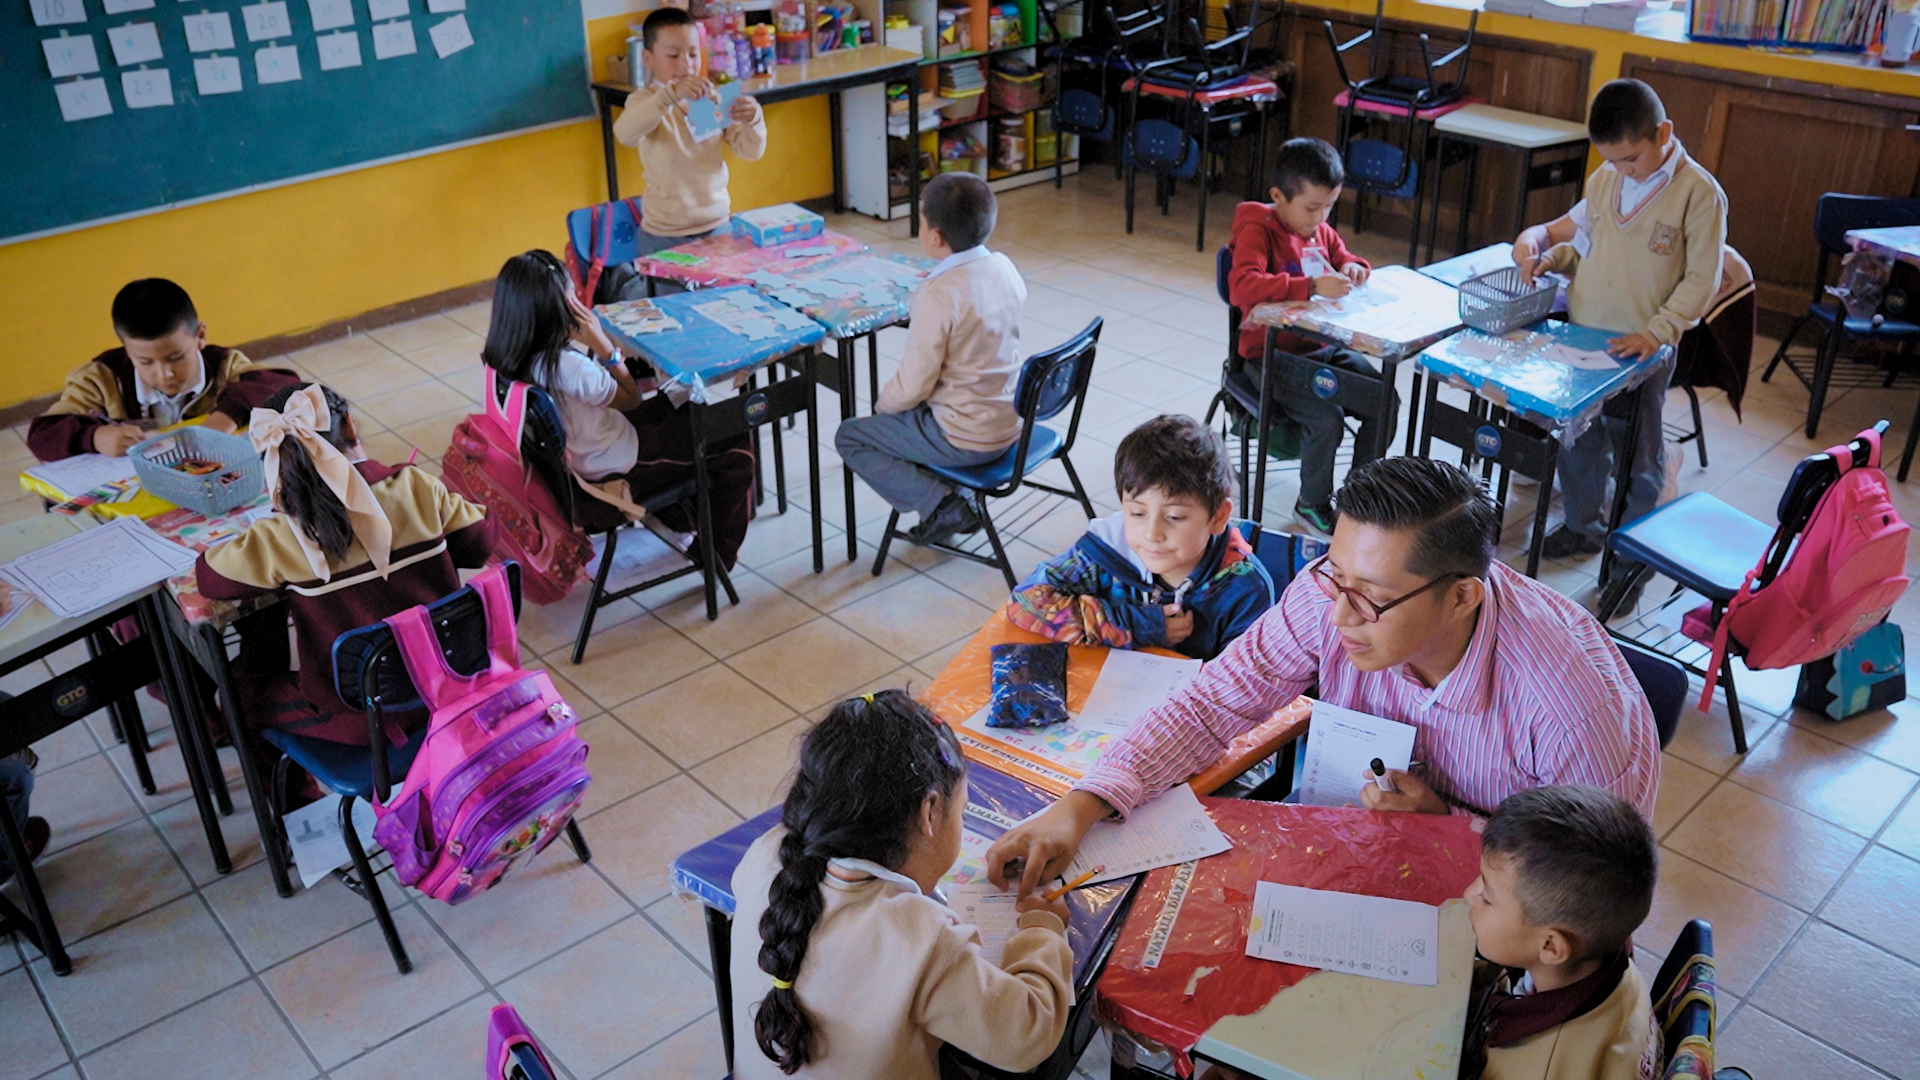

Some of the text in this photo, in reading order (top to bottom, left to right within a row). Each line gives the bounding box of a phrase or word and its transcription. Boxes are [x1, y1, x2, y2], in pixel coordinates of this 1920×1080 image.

[196, 20, 215, 40] 19
[257, 13, 278, 30] 20
[746, 401, 766, 415] GTO
[56, 685, 87, 708] GTO
[1148, 910, 1176, 957] NATALIA
